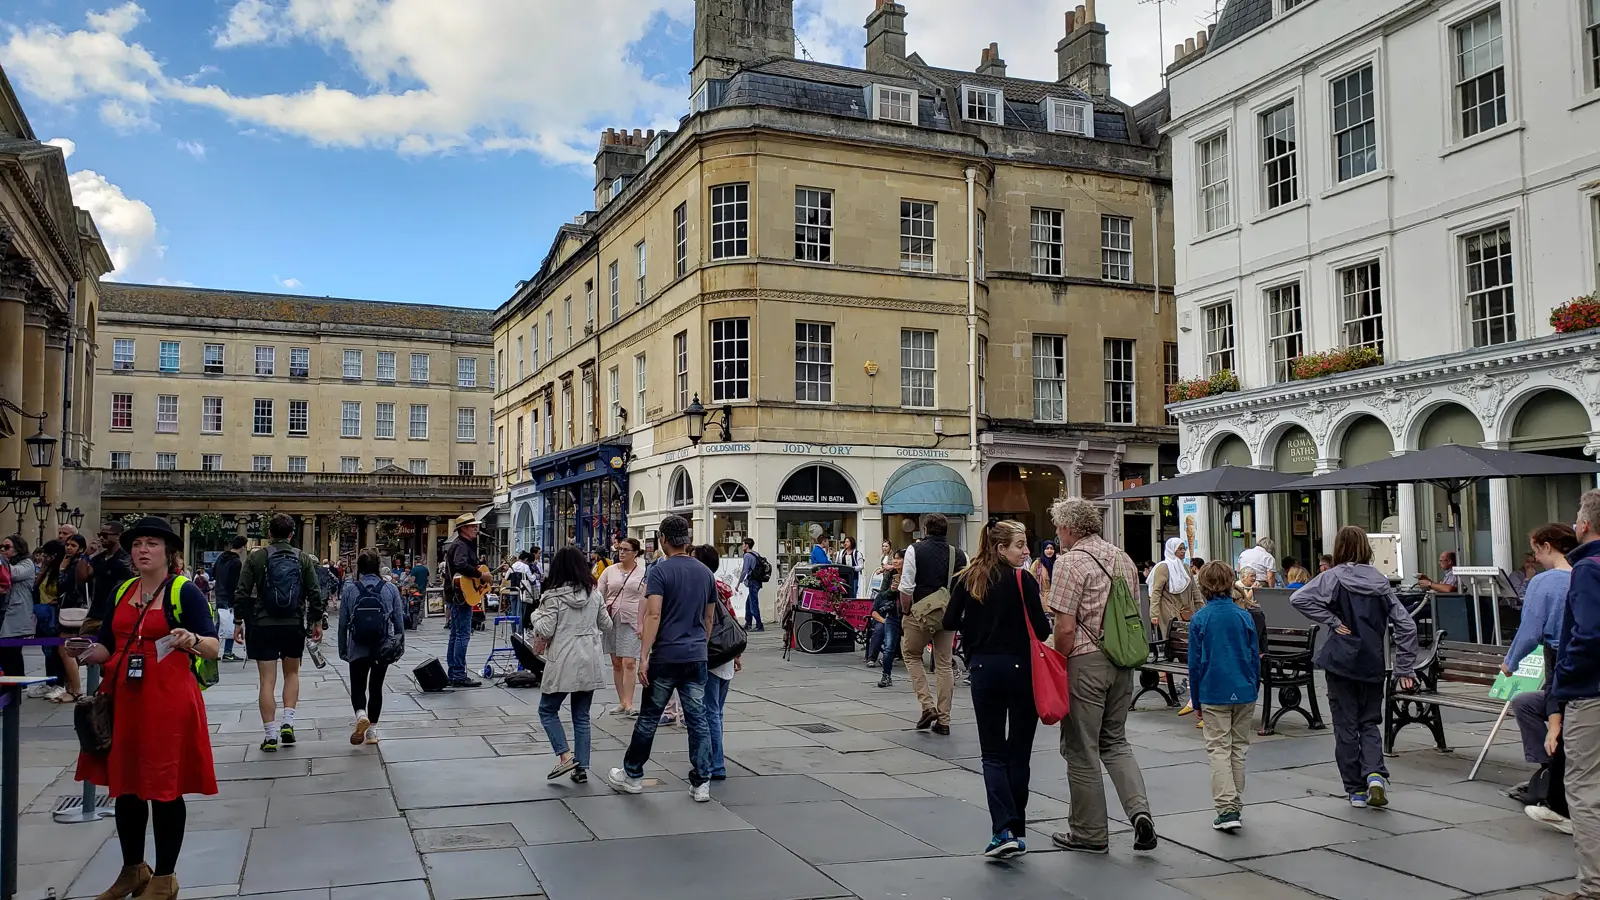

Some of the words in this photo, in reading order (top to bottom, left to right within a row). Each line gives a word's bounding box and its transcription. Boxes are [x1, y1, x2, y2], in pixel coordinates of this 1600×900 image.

[705, 443, 751, 453] GOLDSMITHS
[782, 443, 813, 454] JODY
[820, 445, 853, 455] CORY
[896, 448, 949, 458] GOLDSMITHS
[1290, 446, 1316, 457] BATHS
[781, 494, 815, 502] HANDMADE
